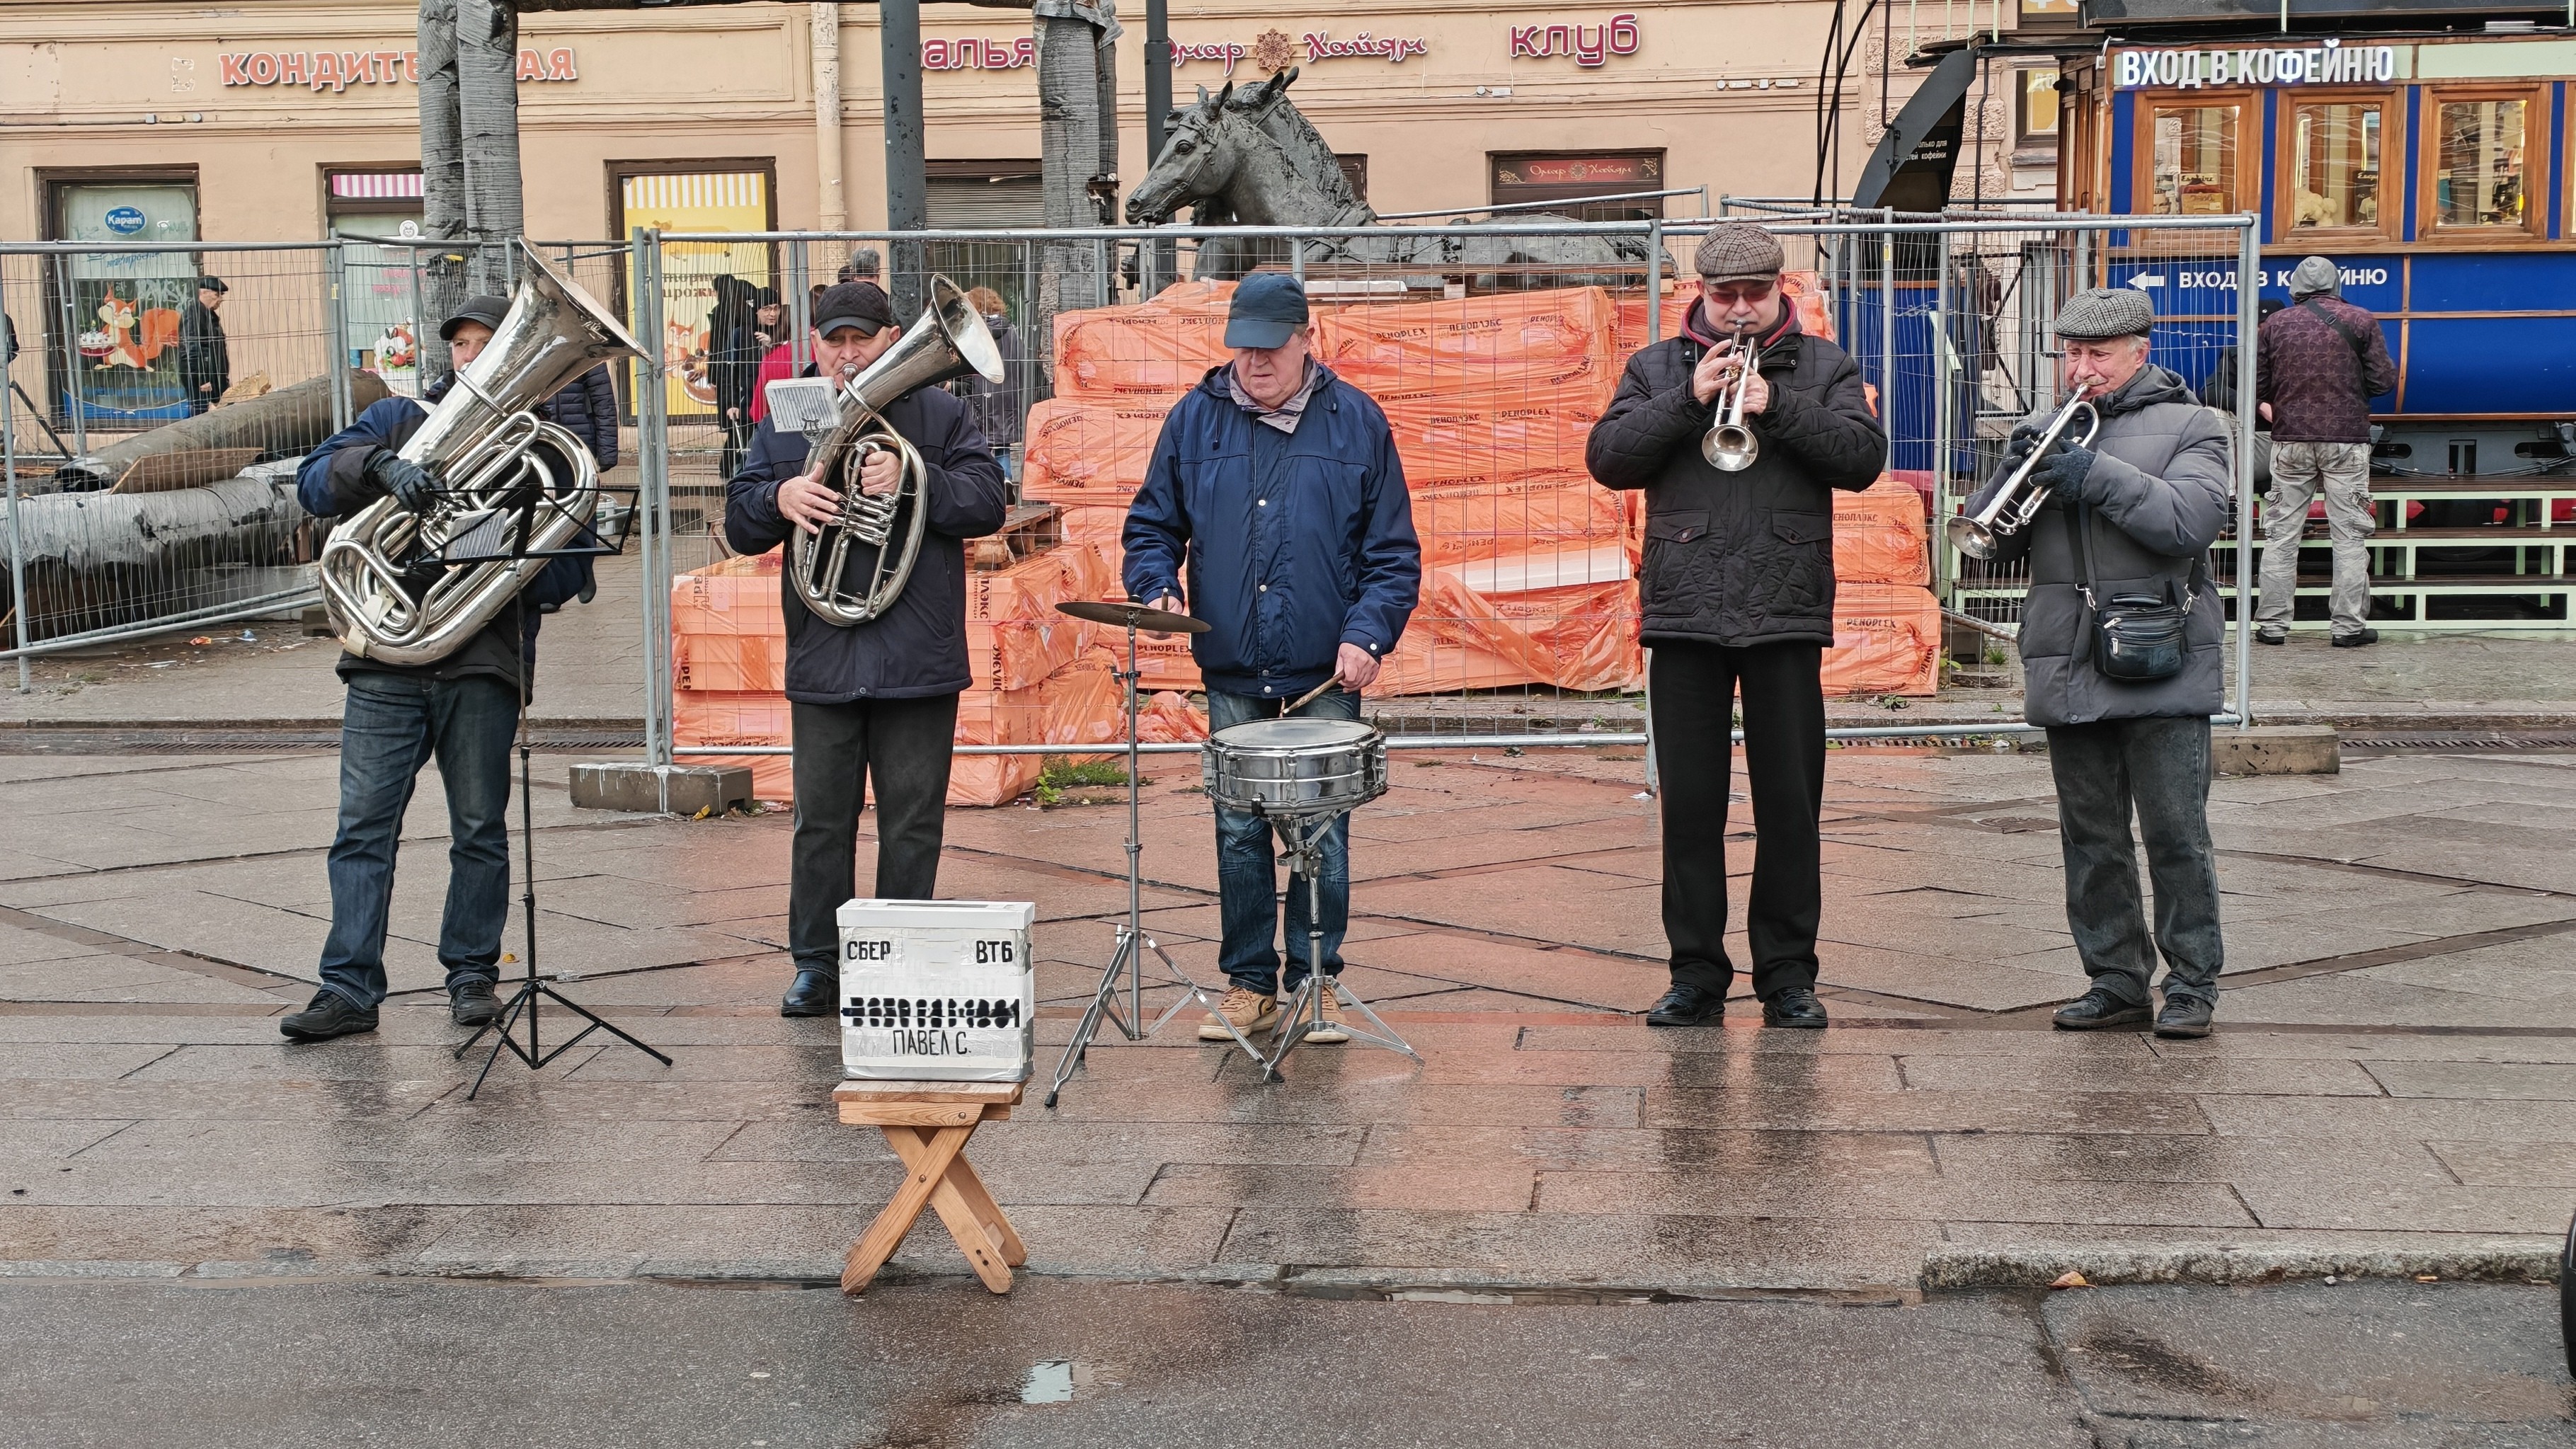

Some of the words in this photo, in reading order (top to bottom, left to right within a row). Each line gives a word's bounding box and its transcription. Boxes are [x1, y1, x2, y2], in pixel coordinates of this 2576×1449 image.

[1303, 30, 1427, 62] Хайям
[1510, 13, 1639, 66] клуб
[922, 36, 1037, 69] алья
[2122, 50, 2202, 89] ВХОД
[2210, 49, 2230, 85] В
[2237, 38, 2394, 85] КОФЕЙНЮ
[219, 47, 578, 93] КОНДИТЕАЯ
[1921, 150, 1947, 161] кофейни
[1529, 164, 1567, 181] Омар
[1588, 164, 1632, 176] Хайям
[662, 273, 714, 286] торт
[2179, 271, 2238, 291] ВХОД
[2277, 265, 2387, 287] КЙНЮ
[1833, 512, 1879, 522] ЕНОПЛЭКС
[847, 941, 891, 960] СБЕР
[976, 940, 1012, 963] ВТБ
[893, 1030, 949, 1055] ПАВЕЛ
[956, 1031, 972, 1055] С.
